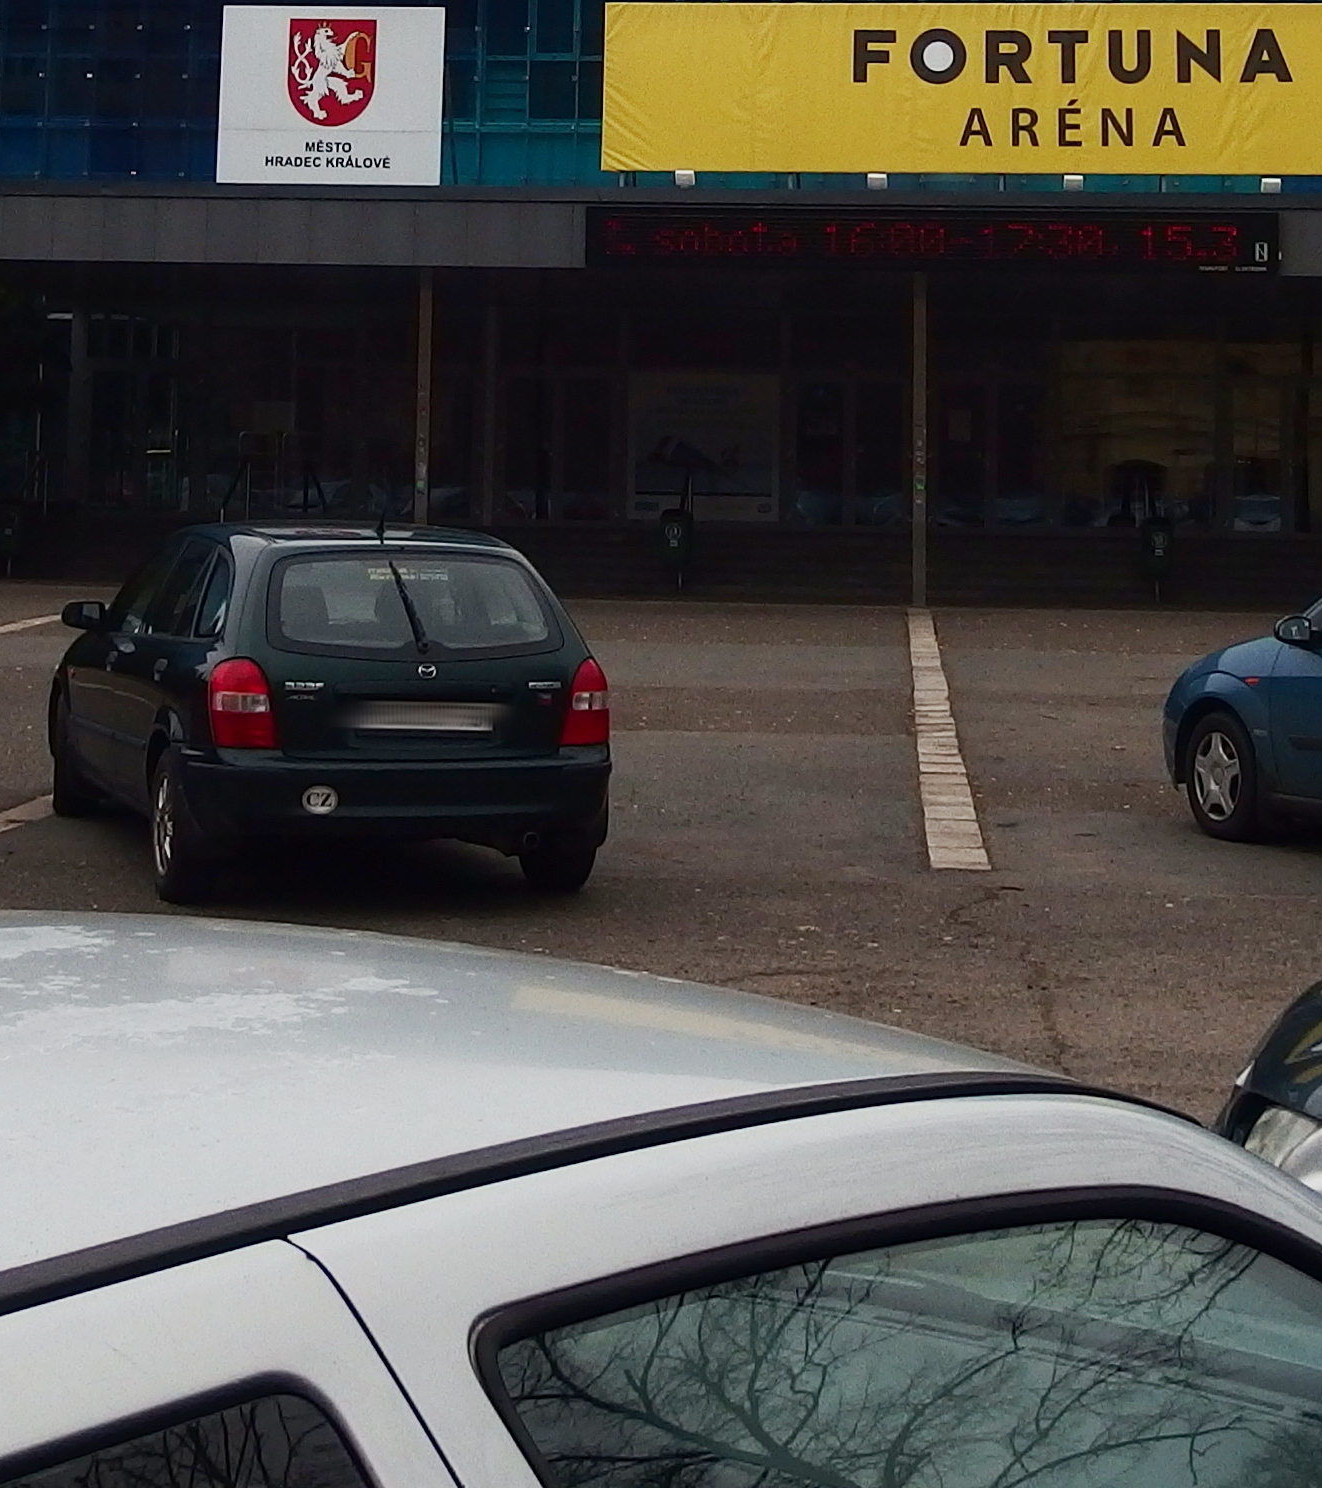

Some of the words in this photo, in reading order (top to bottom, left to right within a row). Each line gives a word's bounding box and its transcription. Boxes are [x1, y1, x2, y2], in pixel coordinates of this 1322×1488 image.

[852, 28, 1294, 85] FORTUNA
[958, 98, 1188, 148] ARÉNA
[305, 139, 352, 153] MĚSTO
[264, 155, 322, 168] HRADEC
[326, 155, 391, 169] KRÁLOVÉ
[307, 792, 332, 808] CZ
